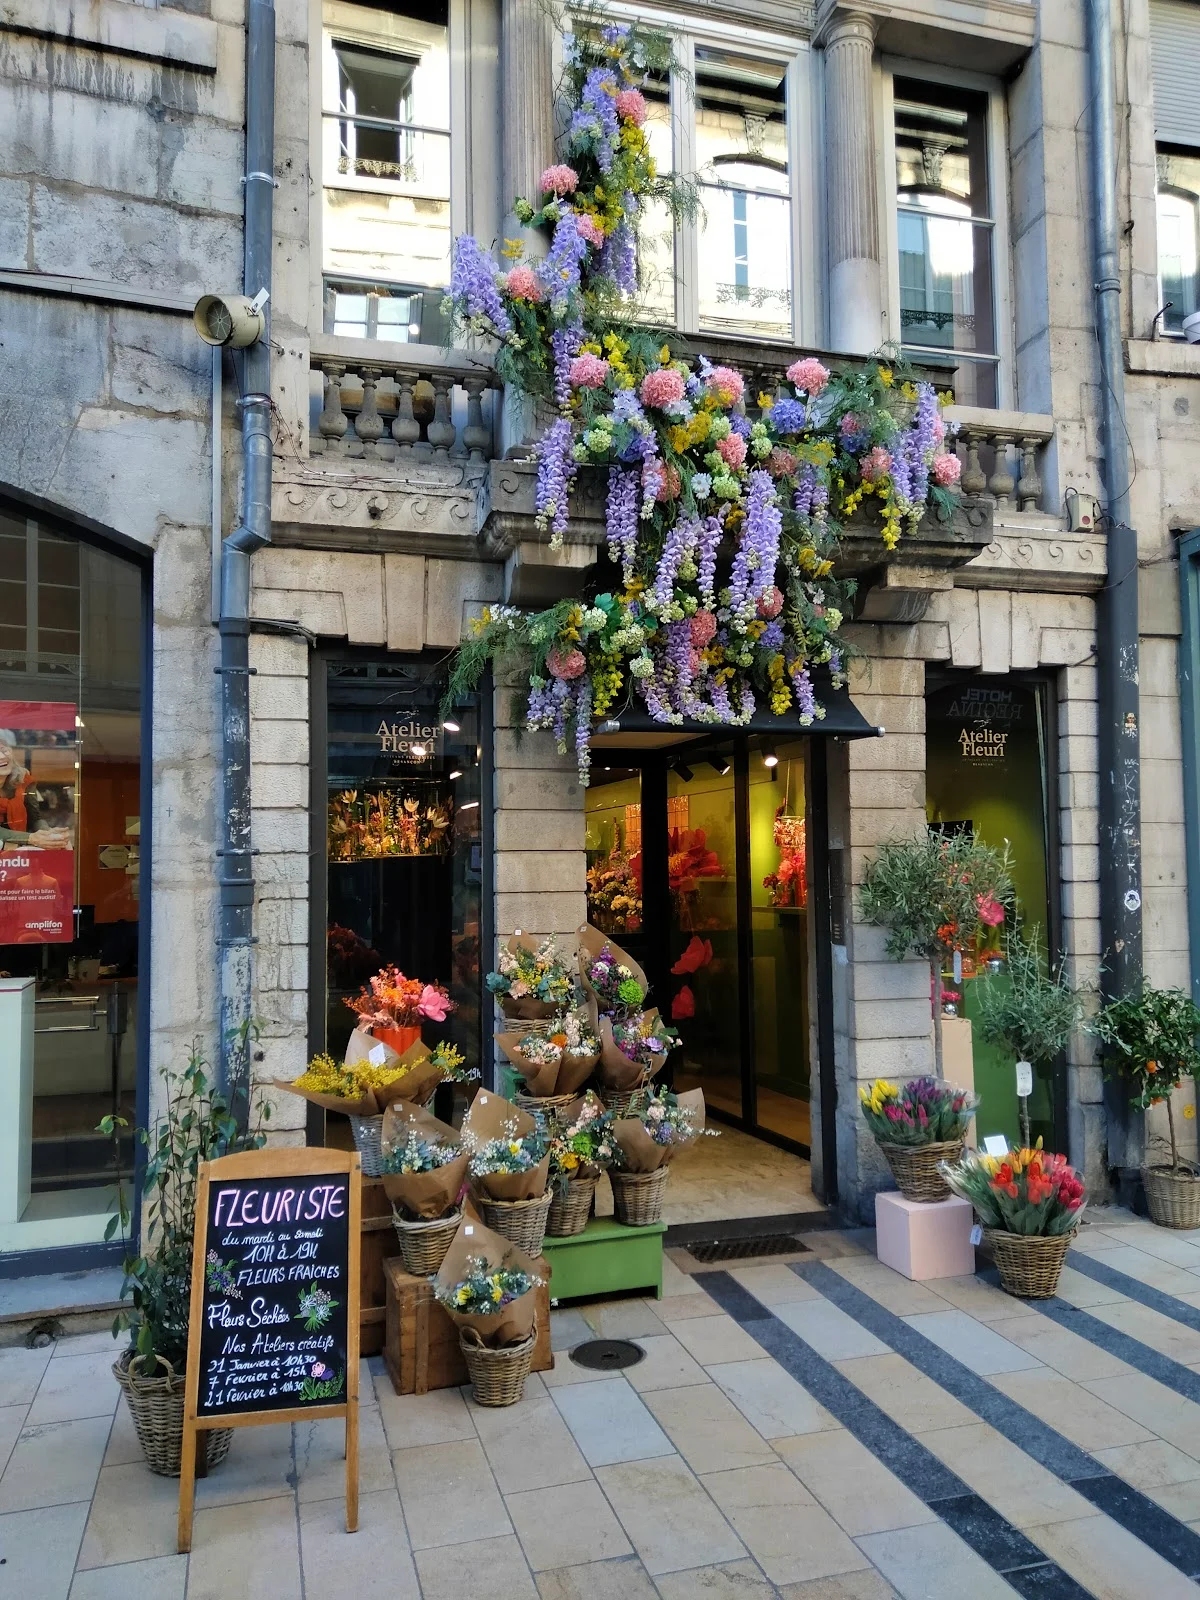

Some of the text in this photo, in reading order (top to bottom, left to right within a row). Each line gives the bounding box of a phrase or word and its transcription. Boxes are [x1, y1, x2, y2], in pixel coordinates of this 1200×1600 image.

[375, 720, 439, 738] Atelier
[958, 728, 1008, 743] Atelier
[380, 736, 436, 754] Fleuri
[962, 742, 1004, 757] Fleuri
[0, 855, 30, 867] ndu
[25, 920, 63, 930] amplifon
[222, 1232, 239, 1246] du
[241, 1231, 275, 1245] mardi
[278, 1233, 291, 1241] au
[243, 1241, 319, 1263] 10H à 19H
[236, 1266, 285, 1287] FLEURS
[207, 1297, 290, 1329] Fleurs Séchées
[221, 1333, 334, 1355] Nos Ateliers créatifs
[207, 1355, 317, 1373] 31 Janvier à 10h30
[209, 1375, 220, 1390] 7
[270, 1367, 281, 1379] à
[284, 1366, 307, 1378] 15h
[204, 1389, 224, 1407] 21
[268, 1383, 279, 1396] à
